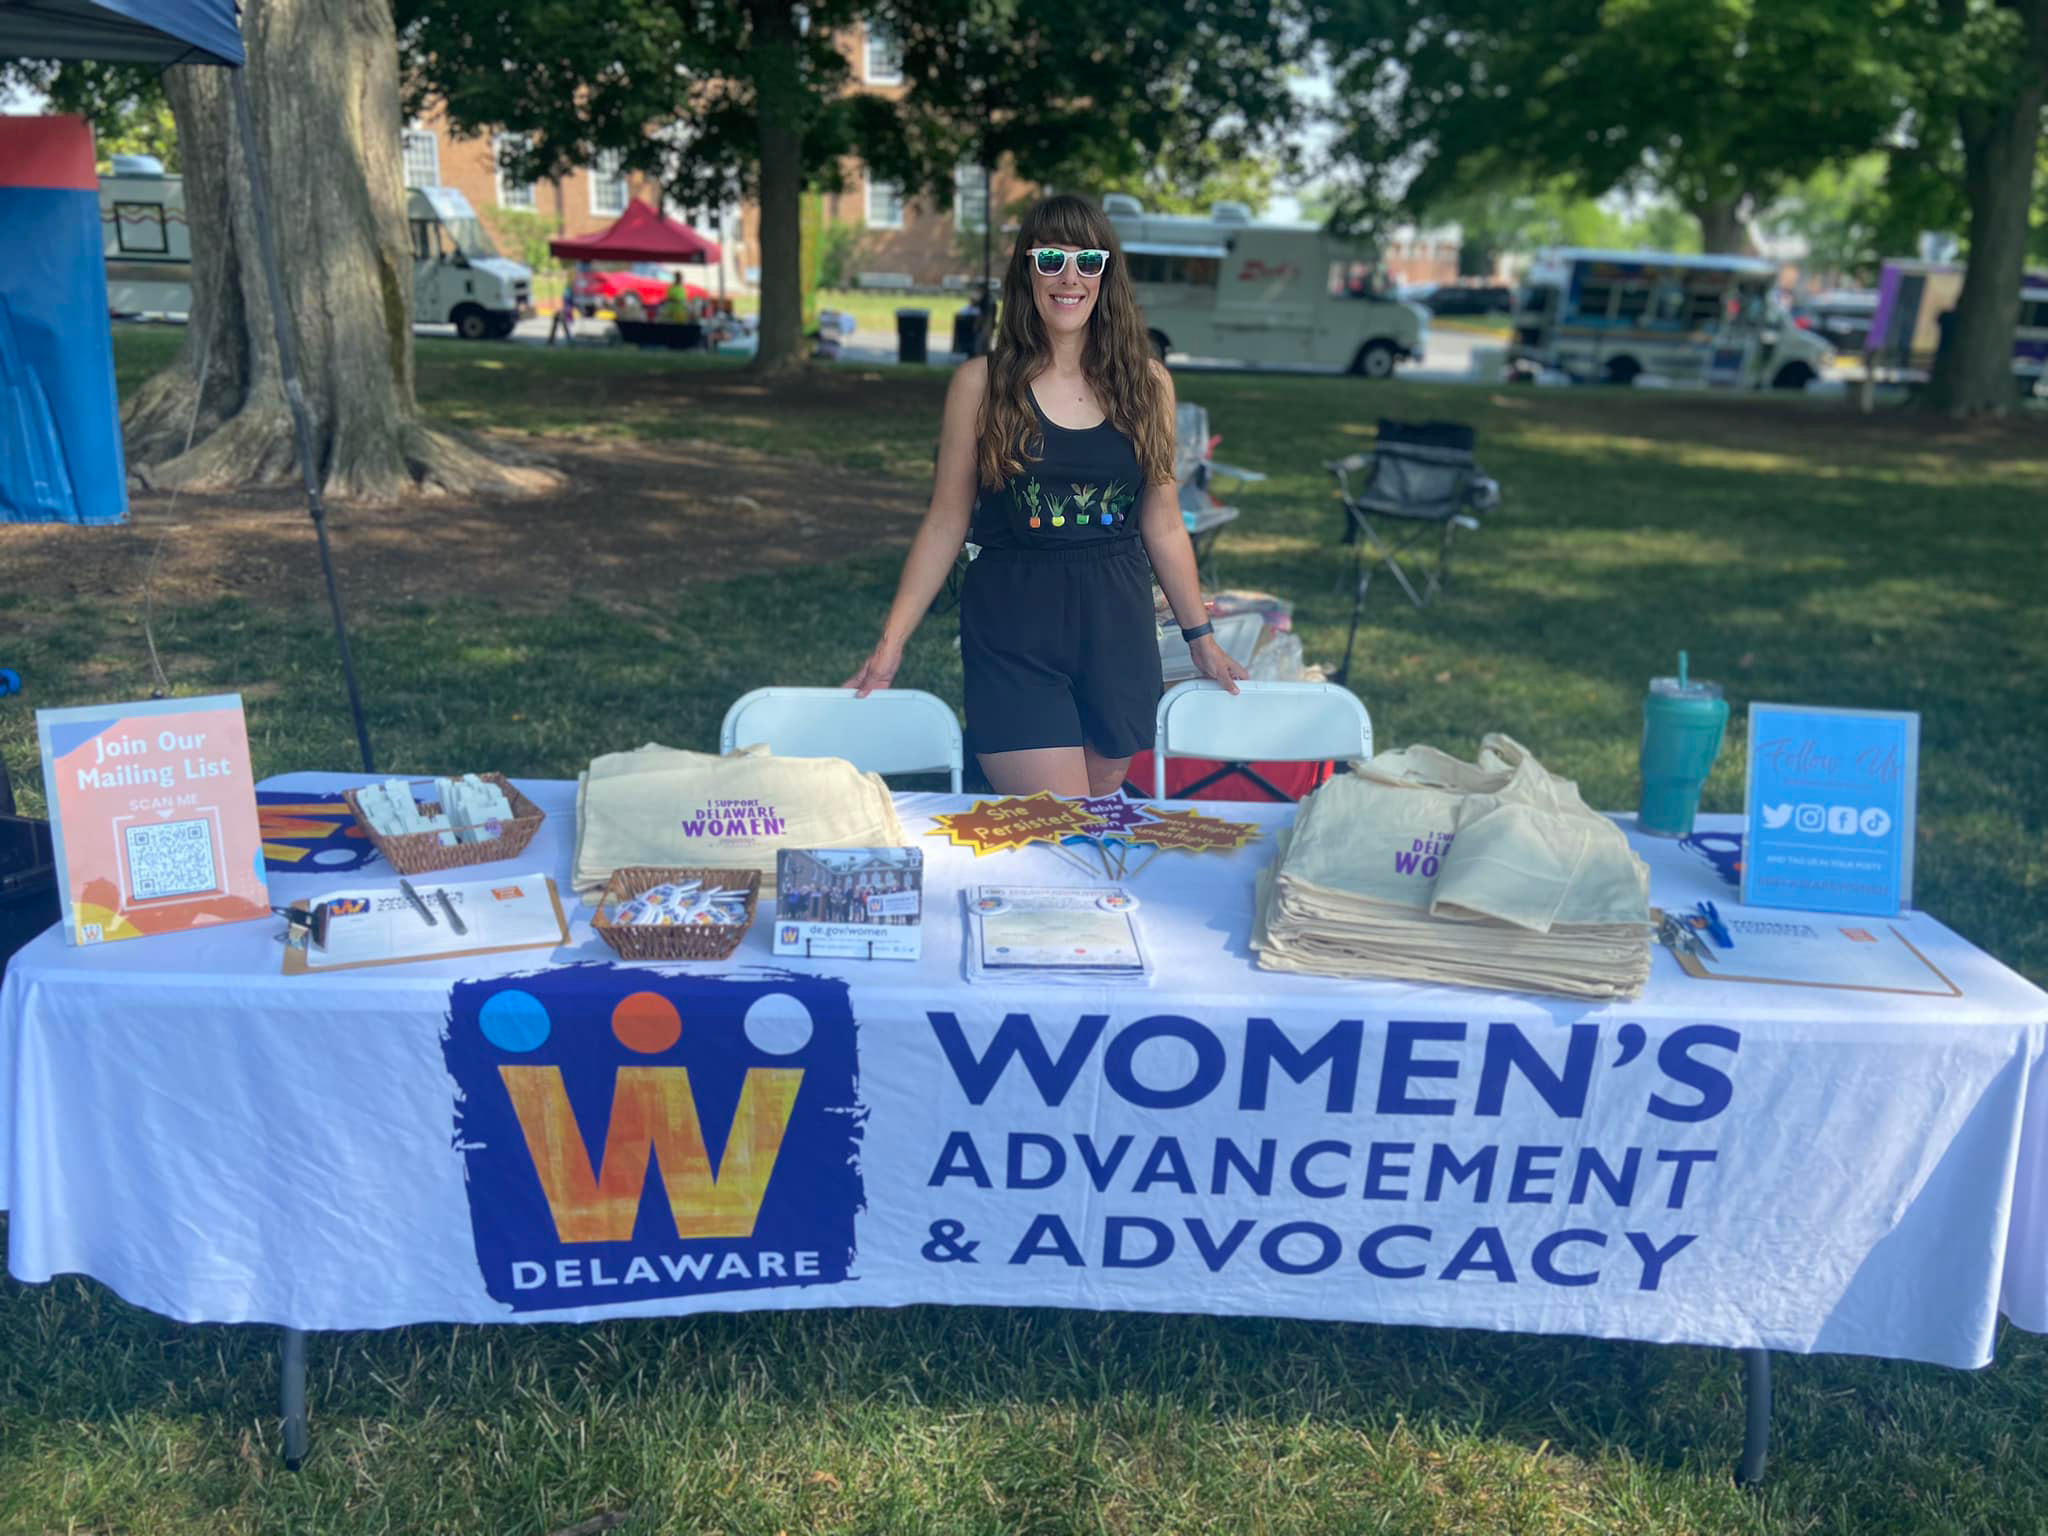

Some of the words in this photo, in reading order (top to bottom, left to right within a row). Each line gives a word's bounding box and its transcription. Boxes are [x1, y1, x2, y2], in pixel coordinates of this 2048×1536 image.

[96, 735, 147, 764] Join
[157, 731, 207, 752] Our
[76, 763, 175, 790] Mailing
[184, 757, 232, 779] List
[129, 797, 174, 811] SCAN
[176, 793, 199, 805] ME
[695, 806, 776, 820] DELAWARE
[714, 799, 760, 808] SUPPORT
[986, 805, 1030, 822] She
[1089, 803, 1124, 813] able
[682, 818, 787, 838] WOMEN!
[973, 811, 1076, 840] Persisted
[1394, 851, 1440, 878] WO
[809, 924, 889, 938] de.gov/women
[925, 1009, 1742, 1123] WOMEN'S
[927, 1130, 1719, 1210] ADVANCEMENT
[919, 1217, 982, 1265] &
[1007, 1212, 1700, 1292] ADVOCACY
[511, 1250, 821, 1290] DELAWARE
